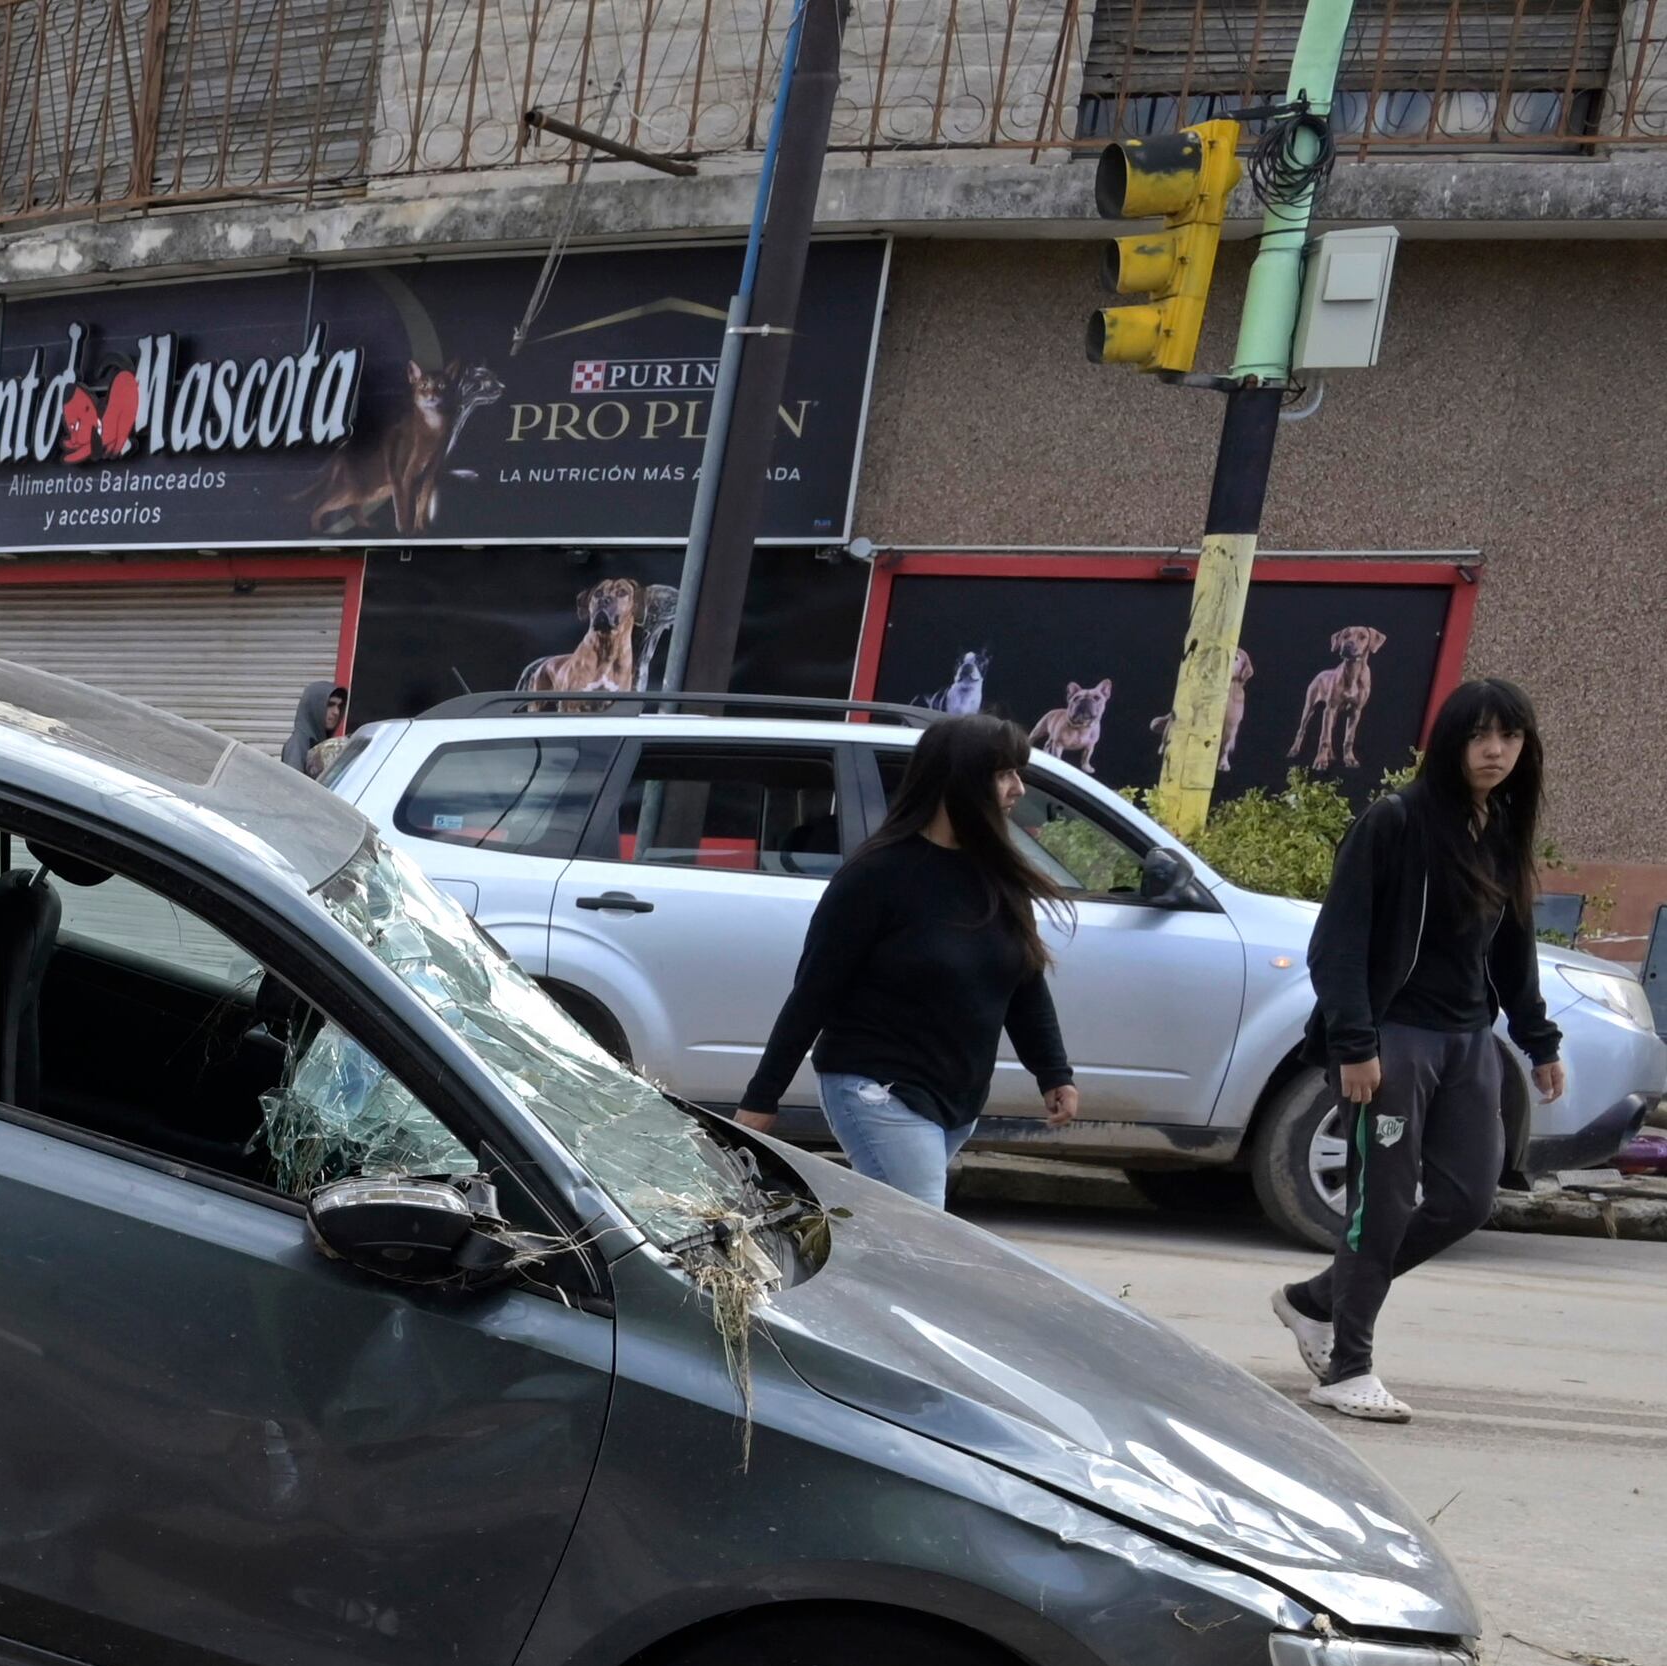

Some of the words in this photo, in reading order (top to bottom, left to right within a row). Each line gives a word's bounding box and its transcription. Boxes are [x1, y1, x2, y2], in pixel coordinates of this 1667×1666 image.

[608, 361, 719, 387] PURIN
[121, 324, 357, 455] Mascota
[505, 401, 631, 442] PRO
[640, 400, 812, 440] PLN
[8, 473, 94, 497] Alimentos
[99, 466, 227, 493] Balanceados
[499, 468, 523, 483] LA
[529, 464, 636, 483] NUTRICIÓN
[643, 464, 686, 481] MÁS
[43, 509, 55, 531] y
[58, 501, 162, 526] accesorios
